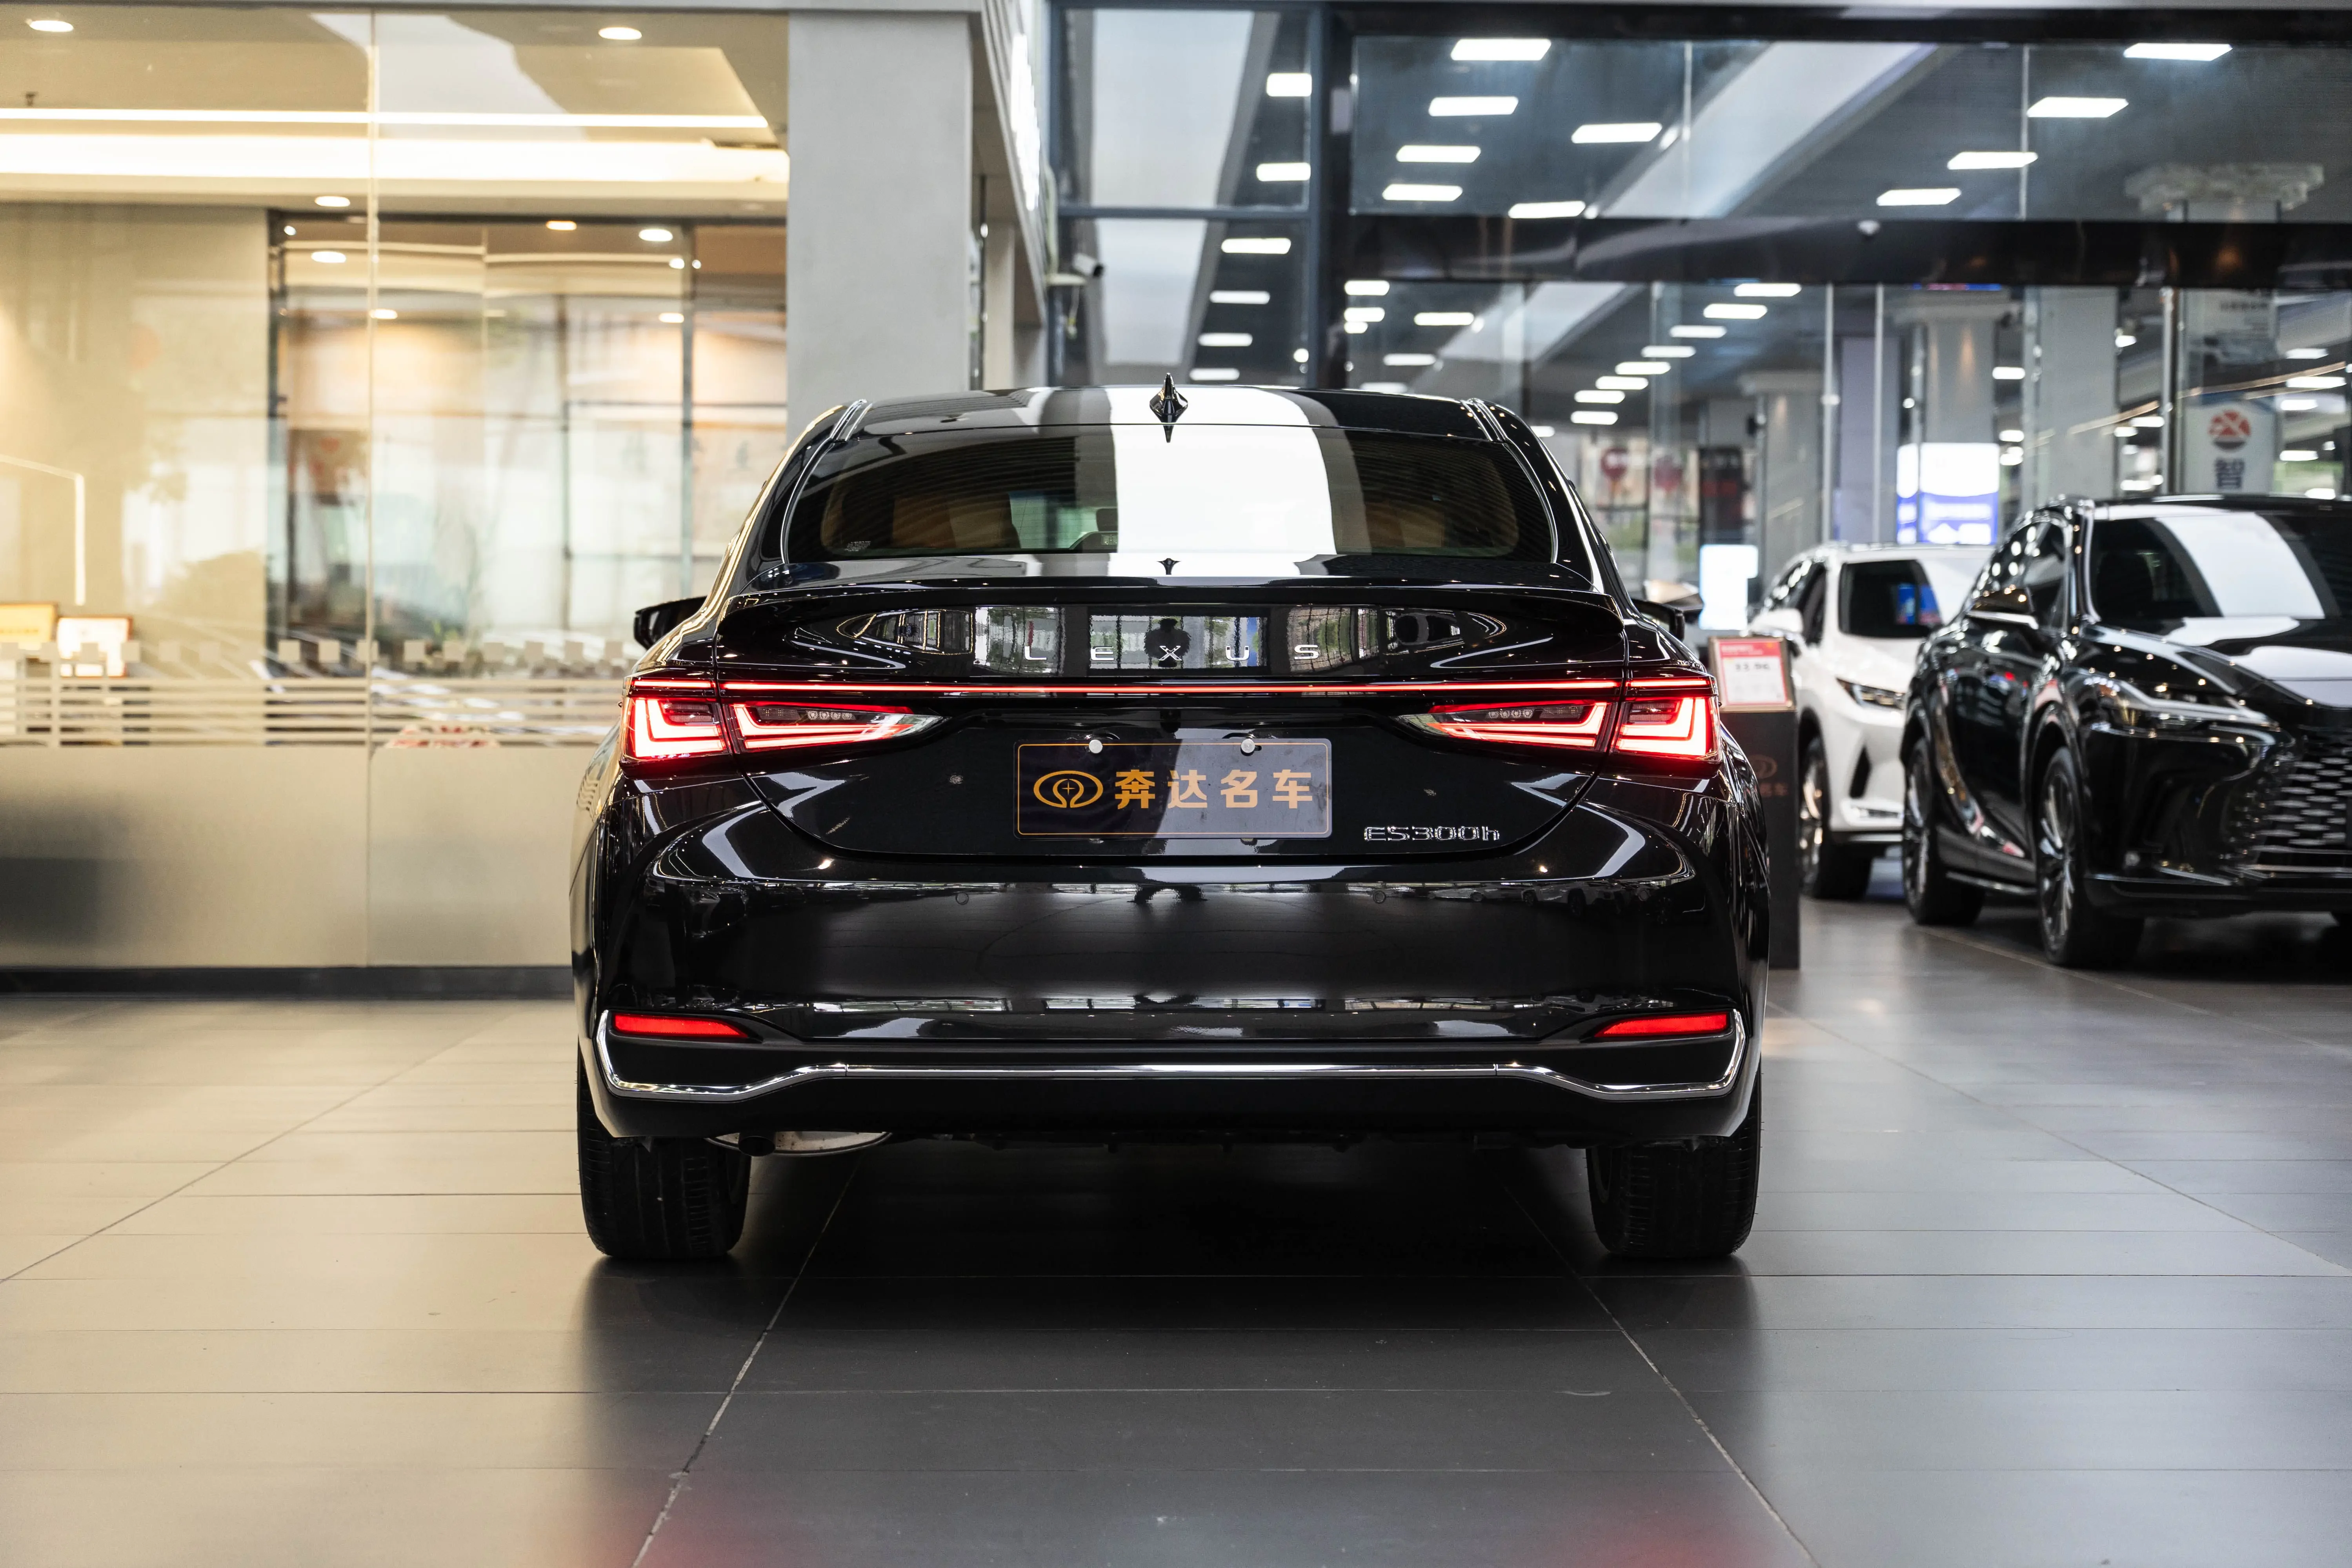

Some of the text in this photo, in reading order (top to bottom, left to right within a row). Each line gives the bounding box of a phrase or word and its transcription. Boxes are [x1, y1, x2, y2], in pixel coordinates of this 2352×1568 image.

[1024, 645, 1319, 661] LEXUS
[1115, 769, 1313, 809] 奔达名车
[1364, 826, 1500, 841] ES300h
